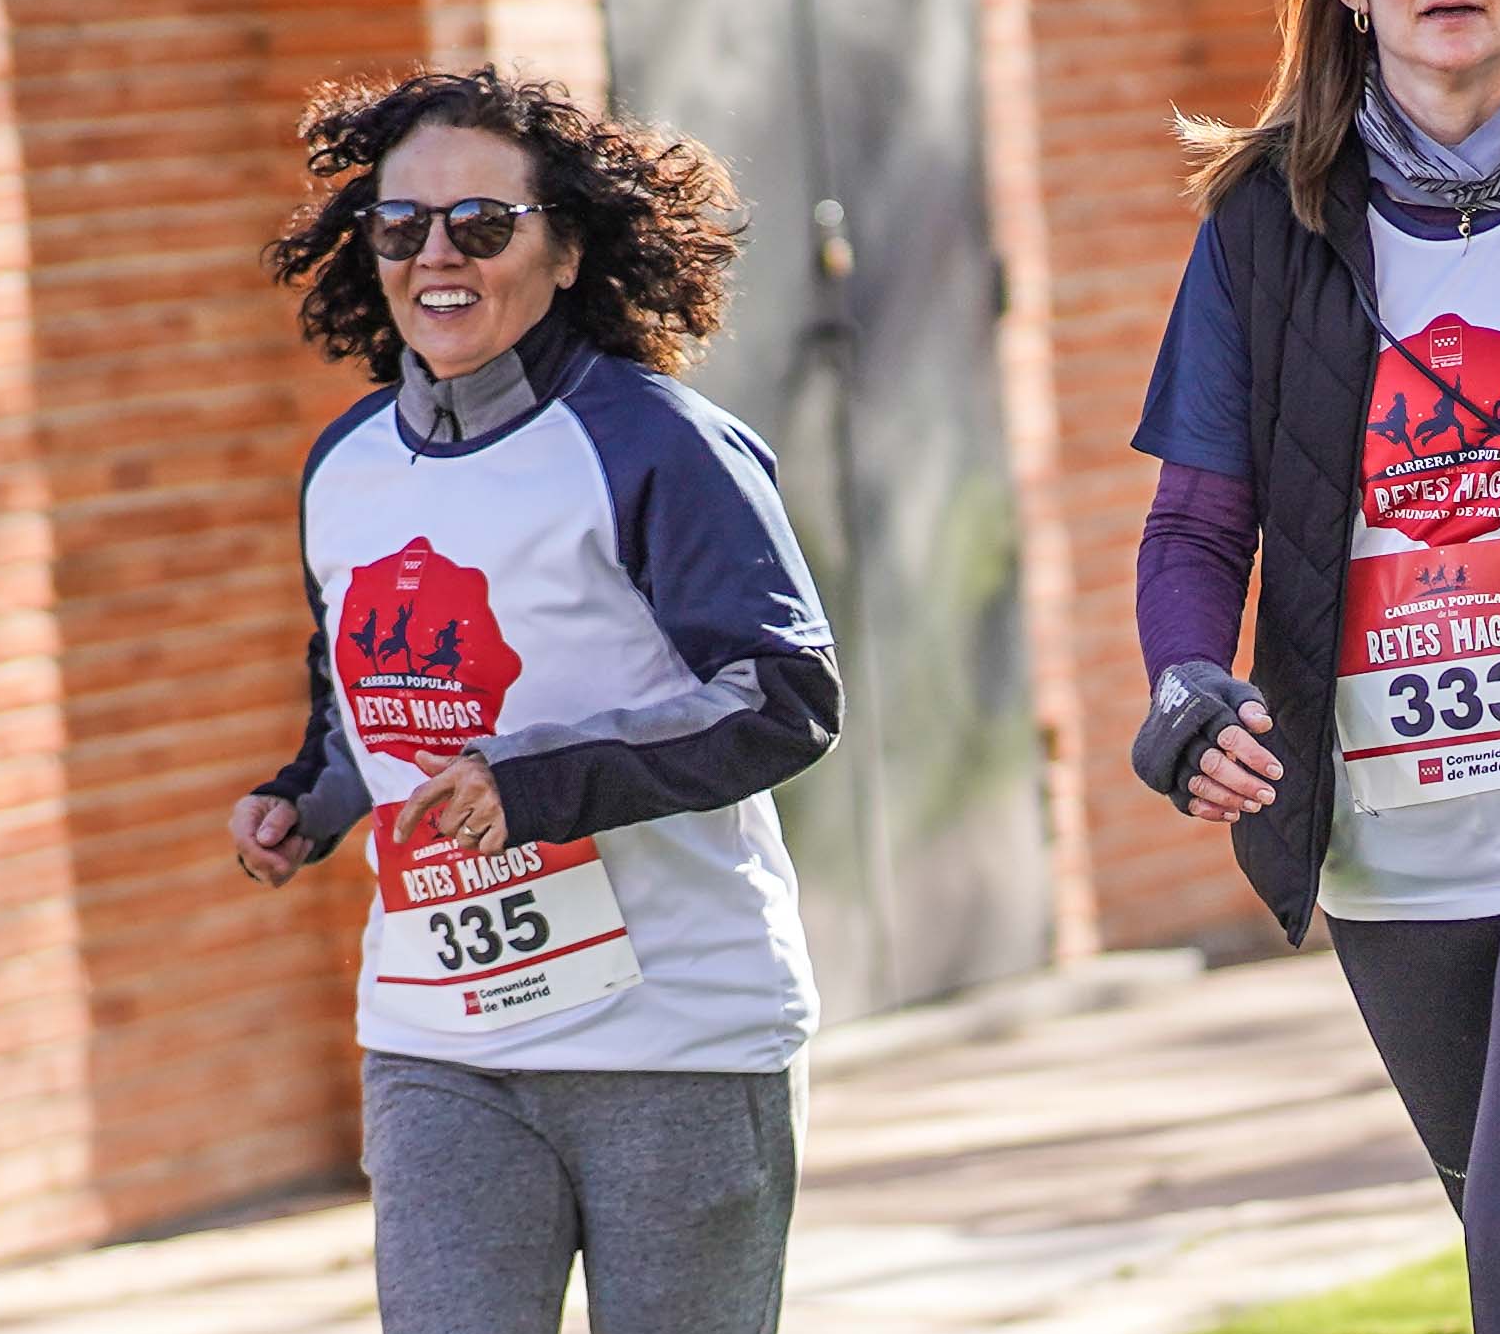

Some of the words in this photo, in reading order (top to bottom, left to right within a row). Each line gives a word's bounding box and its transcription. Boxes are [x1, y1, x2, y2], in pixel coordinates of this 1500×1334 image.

[1385, 454, 1455, 477] CARRERA
[1374, 477, 1450, 514] REYES
[1456, 506, 1473, 517] DE
[1384, 598, 1445, 619] CARRERA
[1366, 623, 1441, 664] REYES
[359, 675, 405, 688] CARRERA
[406, 676, 463, 693] POPULAR
[355, 695, 408, 727] REYES
[409, 700, 483, 730] MAGOS
[1447, 769, 1464, 781] de
[401, 864, 457, 903] REYES
[456, 841, 543, 895] MAGOS
[429, 889, 550, 971] 335
[479, 973, 547, 999] Comunidad
[483, 1002, 498, 1014] de
[502, 986, 551, 1009] Madrid
